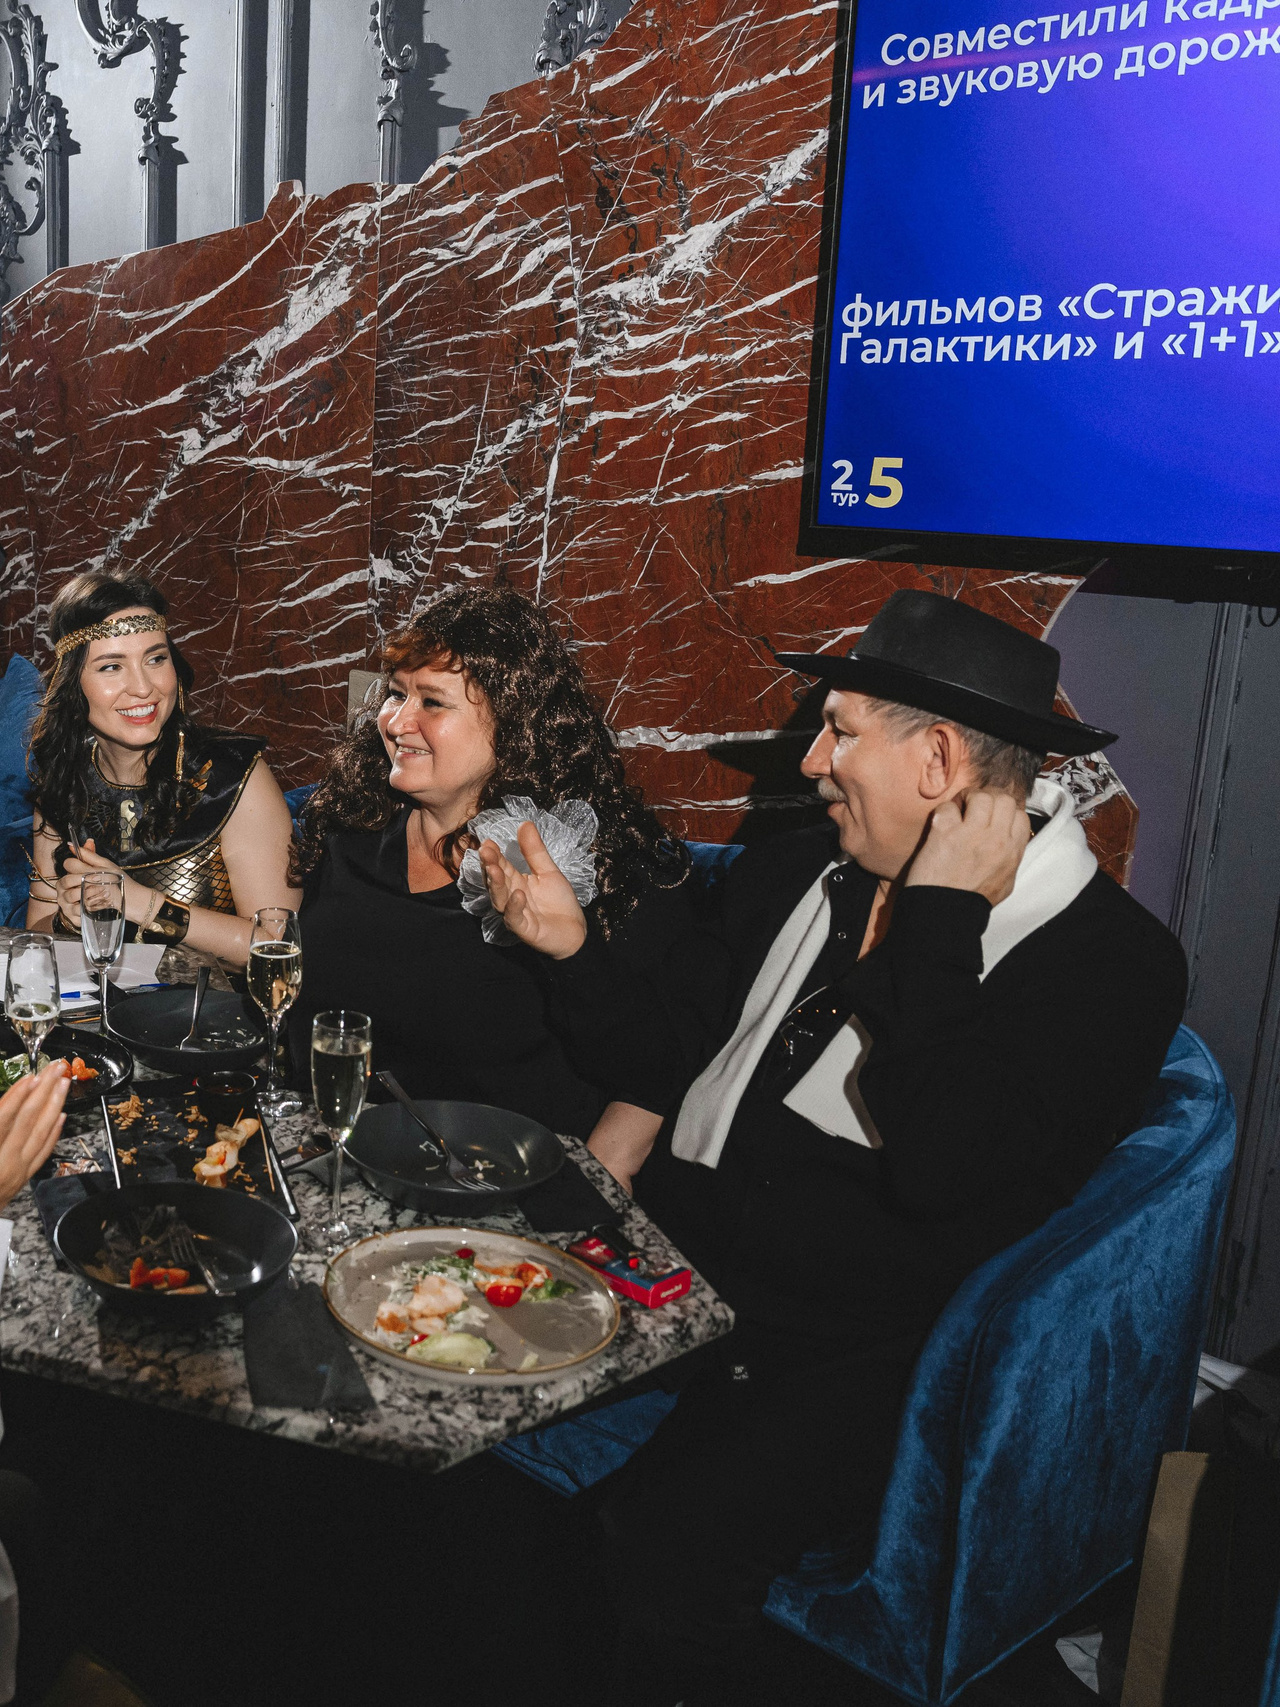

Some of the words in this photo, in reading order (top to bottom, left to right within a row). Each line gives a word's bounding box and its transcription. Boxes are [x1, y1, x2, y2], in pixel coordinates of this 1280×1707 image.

[881, 1, 1147, 66] Совместили
[862, 82, 885, 109] и
[896, 52, 1104, 107] звуковую
[1113, 26, 1280, 80] дорож
[841, 293, 1043, 334] фильмов
[839, 332, 1098, 364] Галактики»
[1113, 331, 1145, 360] и
[1161, 319, 1280, 359] «1+1»
[831, 459, 853, 491] 2
[864, 456, 903, 509] 5
[831, 492, 860, 507] тур
